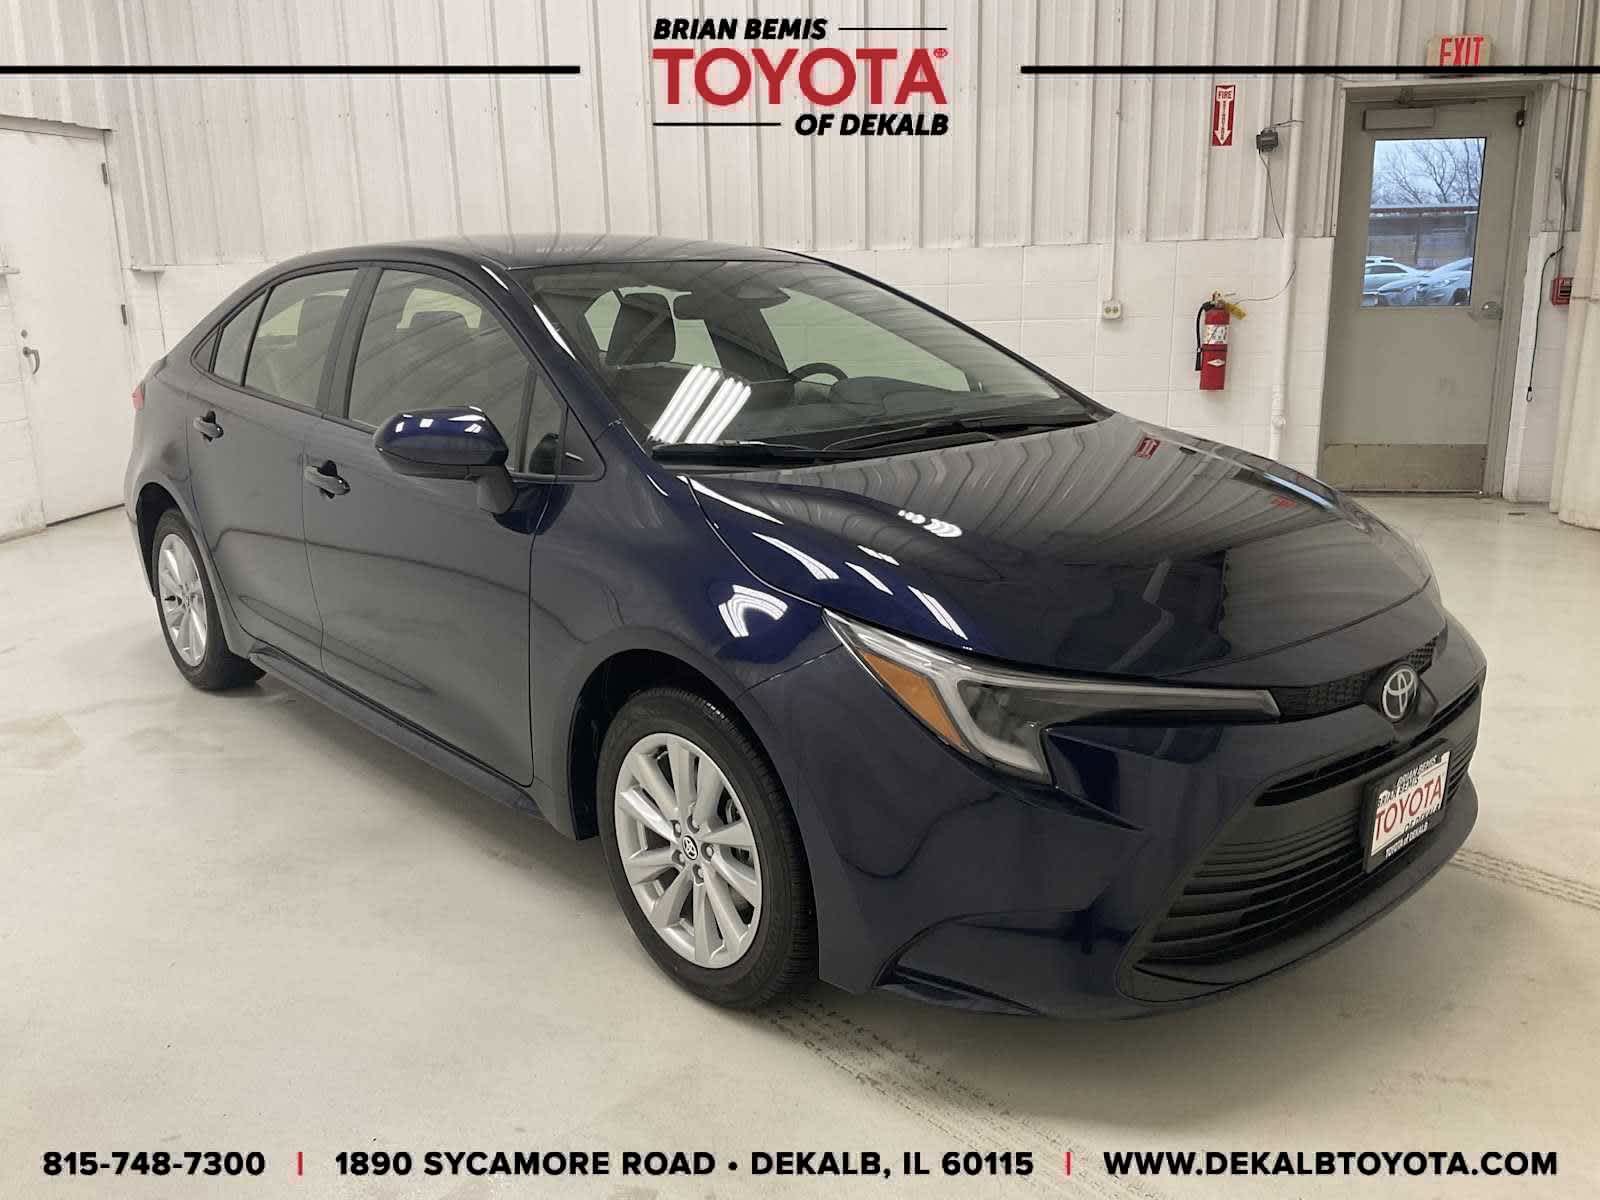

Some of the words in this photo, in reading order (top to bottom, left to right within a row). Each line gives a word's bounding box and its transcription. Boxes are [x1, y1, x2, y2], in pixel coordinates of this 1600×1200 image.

[1440, 36, 1484, 66] EXIT
[1218, 90, 1232, 99] FIRE
[1375, 775, 1441, 841] TOYOTA
